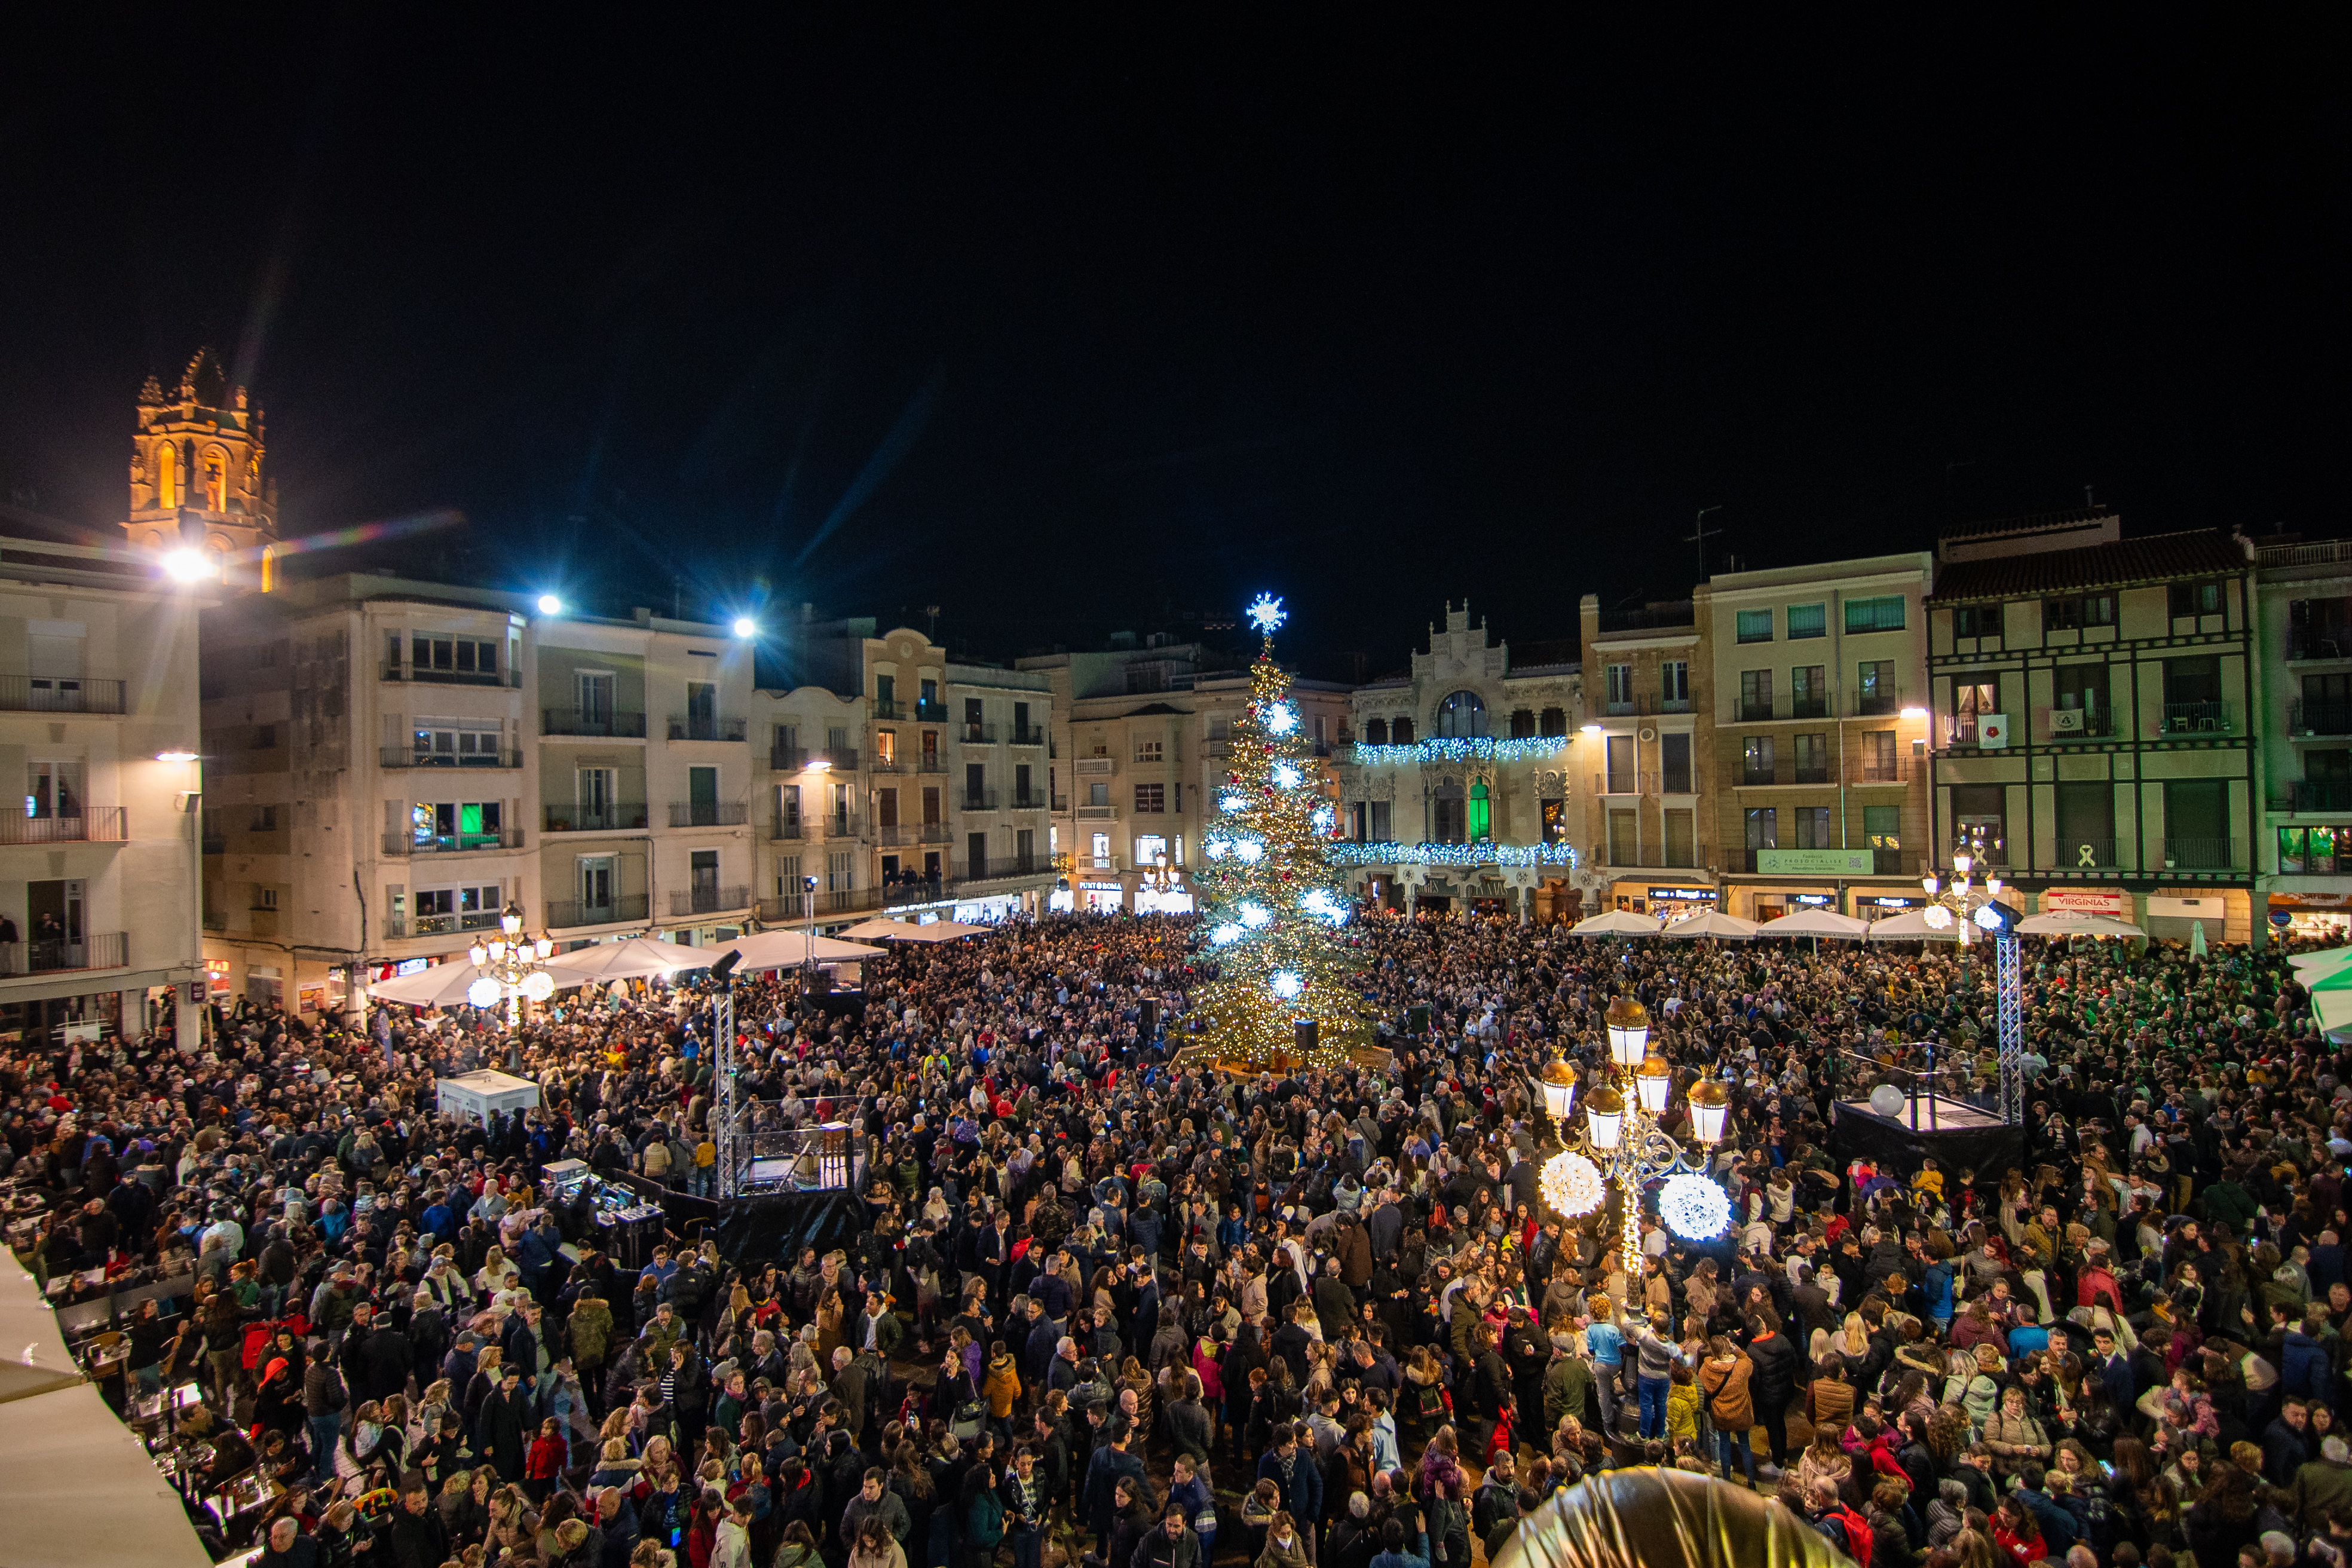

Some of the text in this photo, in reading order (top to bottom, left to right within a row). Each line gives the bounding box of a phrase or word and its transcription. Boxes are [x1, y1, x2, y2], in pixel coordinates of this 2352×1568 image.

[958, 885, 1039, 899] FARMACIA MONTEVERDE
[2058, 898, 2110, 906] VIRGINIAS
